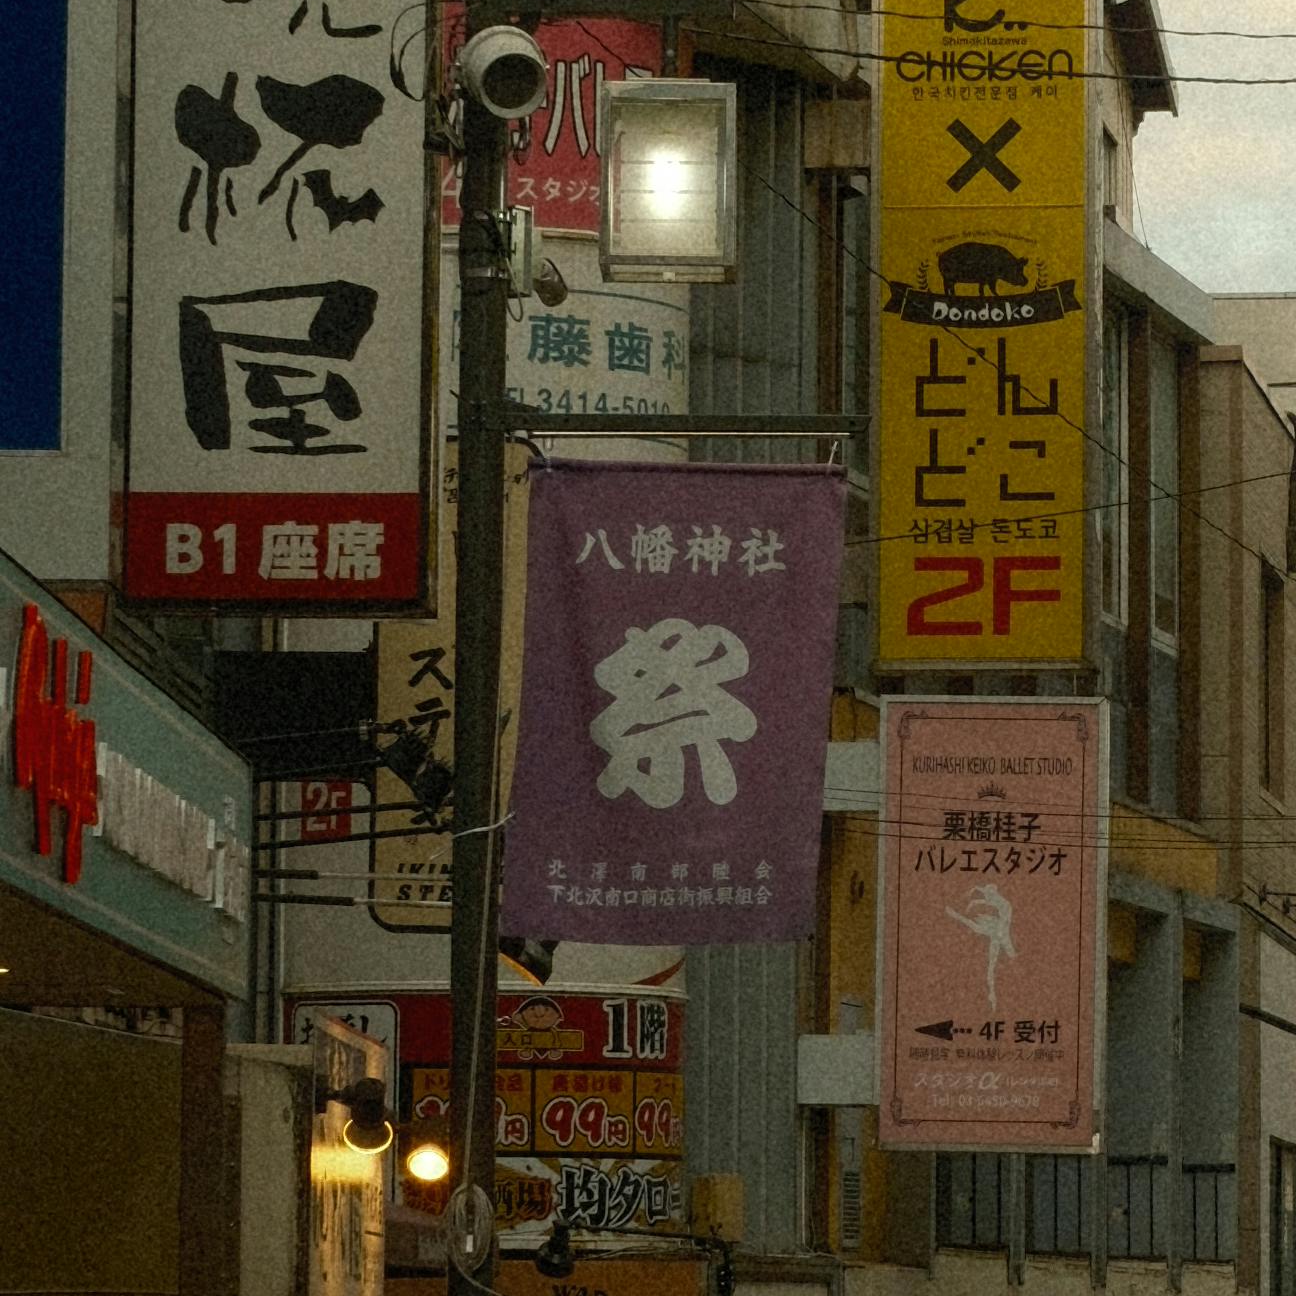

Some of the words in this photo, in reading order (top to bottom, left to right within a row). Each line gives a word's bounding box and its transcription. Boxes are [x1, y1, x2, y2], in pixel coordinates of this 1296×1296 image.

[932, 301, 1035, 322] Dondoko
[914, 337, 1058, 417] どん
[914, 428, 1056, 508] どこ
[165, 521, 385, 581] B1座席
[575, 523, 786, 577] 八幡神社
[909, 517, 975, 545] 삼겹살
[907, 555, 1061, 636] 2F
[589, 618, 758, 808] 祭
[1000, 757, 1035, 775] BALLET
[1037, 757, 1073, 775] STUDIO
[943, 811, 1041, 843] 栗橋桂子
[915, 847, 1068, 876] バレエスタジオ
[979, 1020, 1005, 1041] 4F
[1014, 1020, 1061, 1045] 受付
